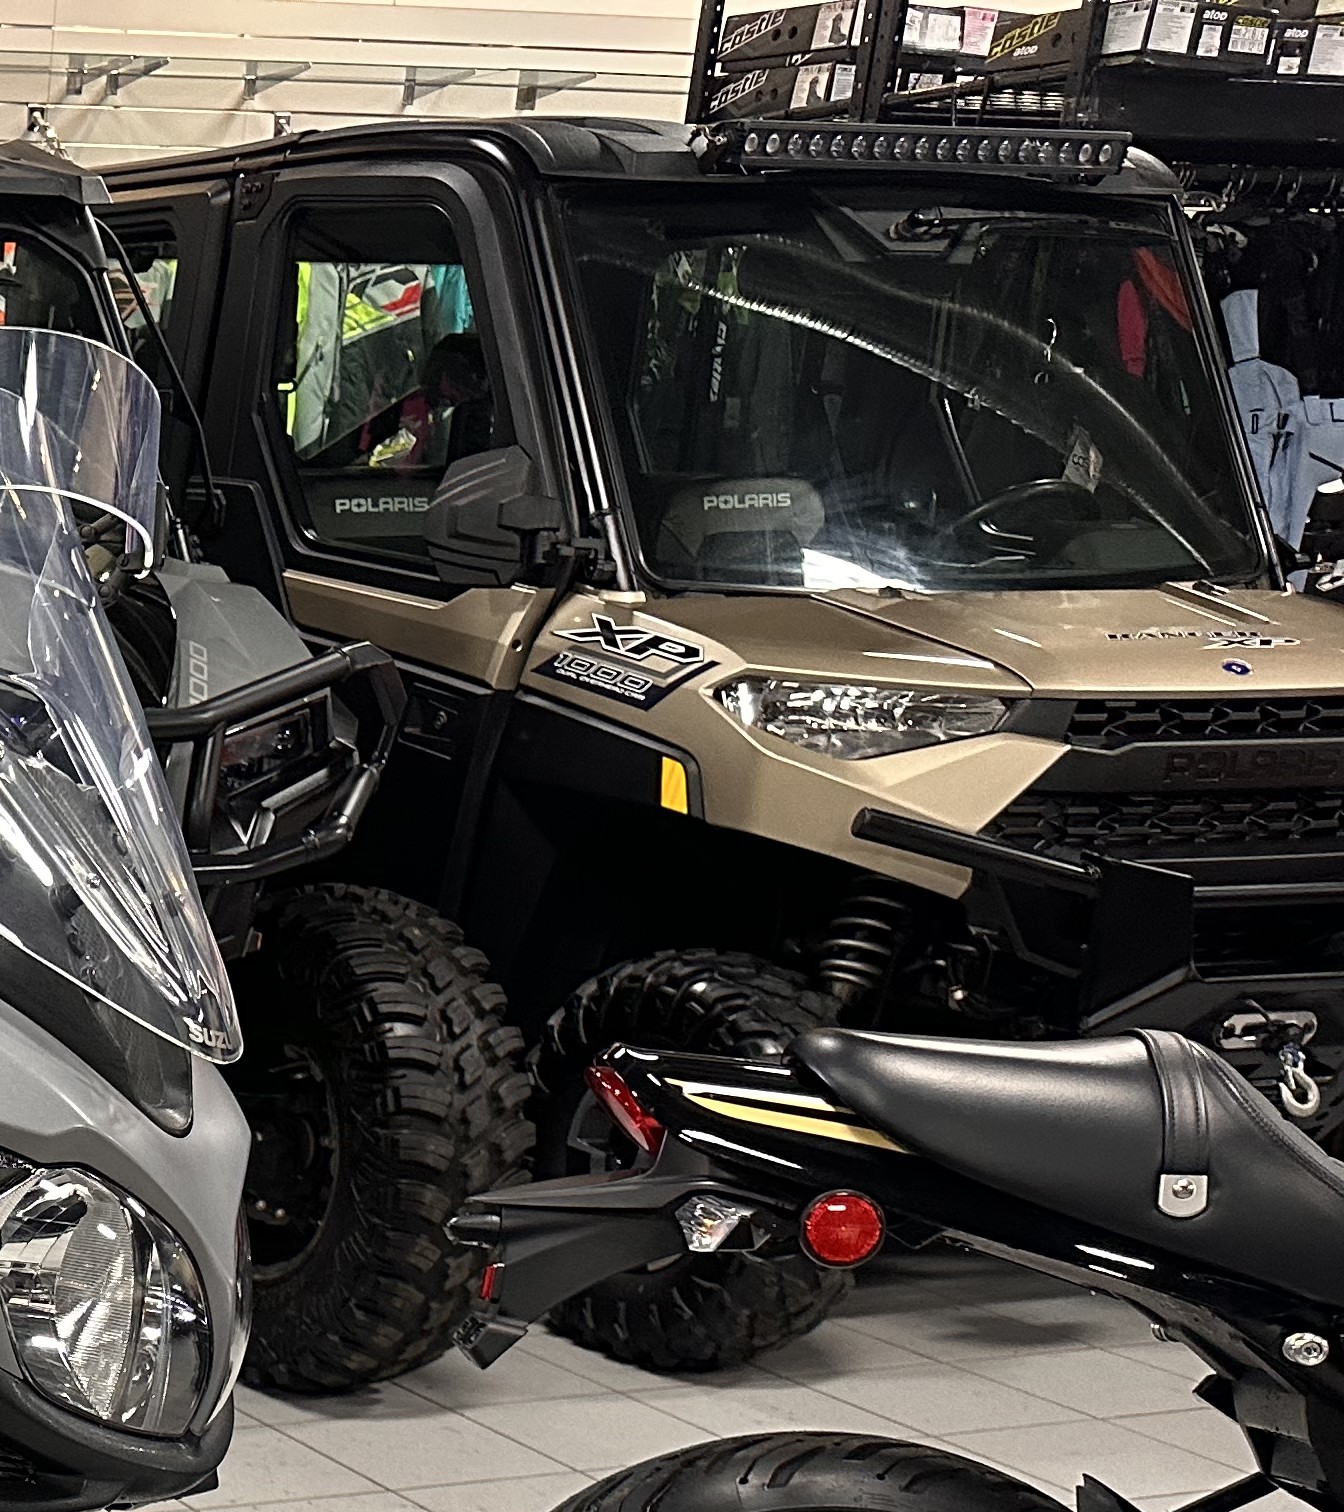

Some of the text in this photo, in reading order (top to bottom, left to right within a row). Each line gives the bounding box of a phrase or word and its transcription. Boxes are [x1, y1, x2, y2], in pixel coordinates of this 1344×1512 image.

[335, 497, 430, 514] POLARIS
[703, 493, 791, 511] POLARIS
[551, 612, 705, 664] XP
[553, 652, 654, 694] 1000
